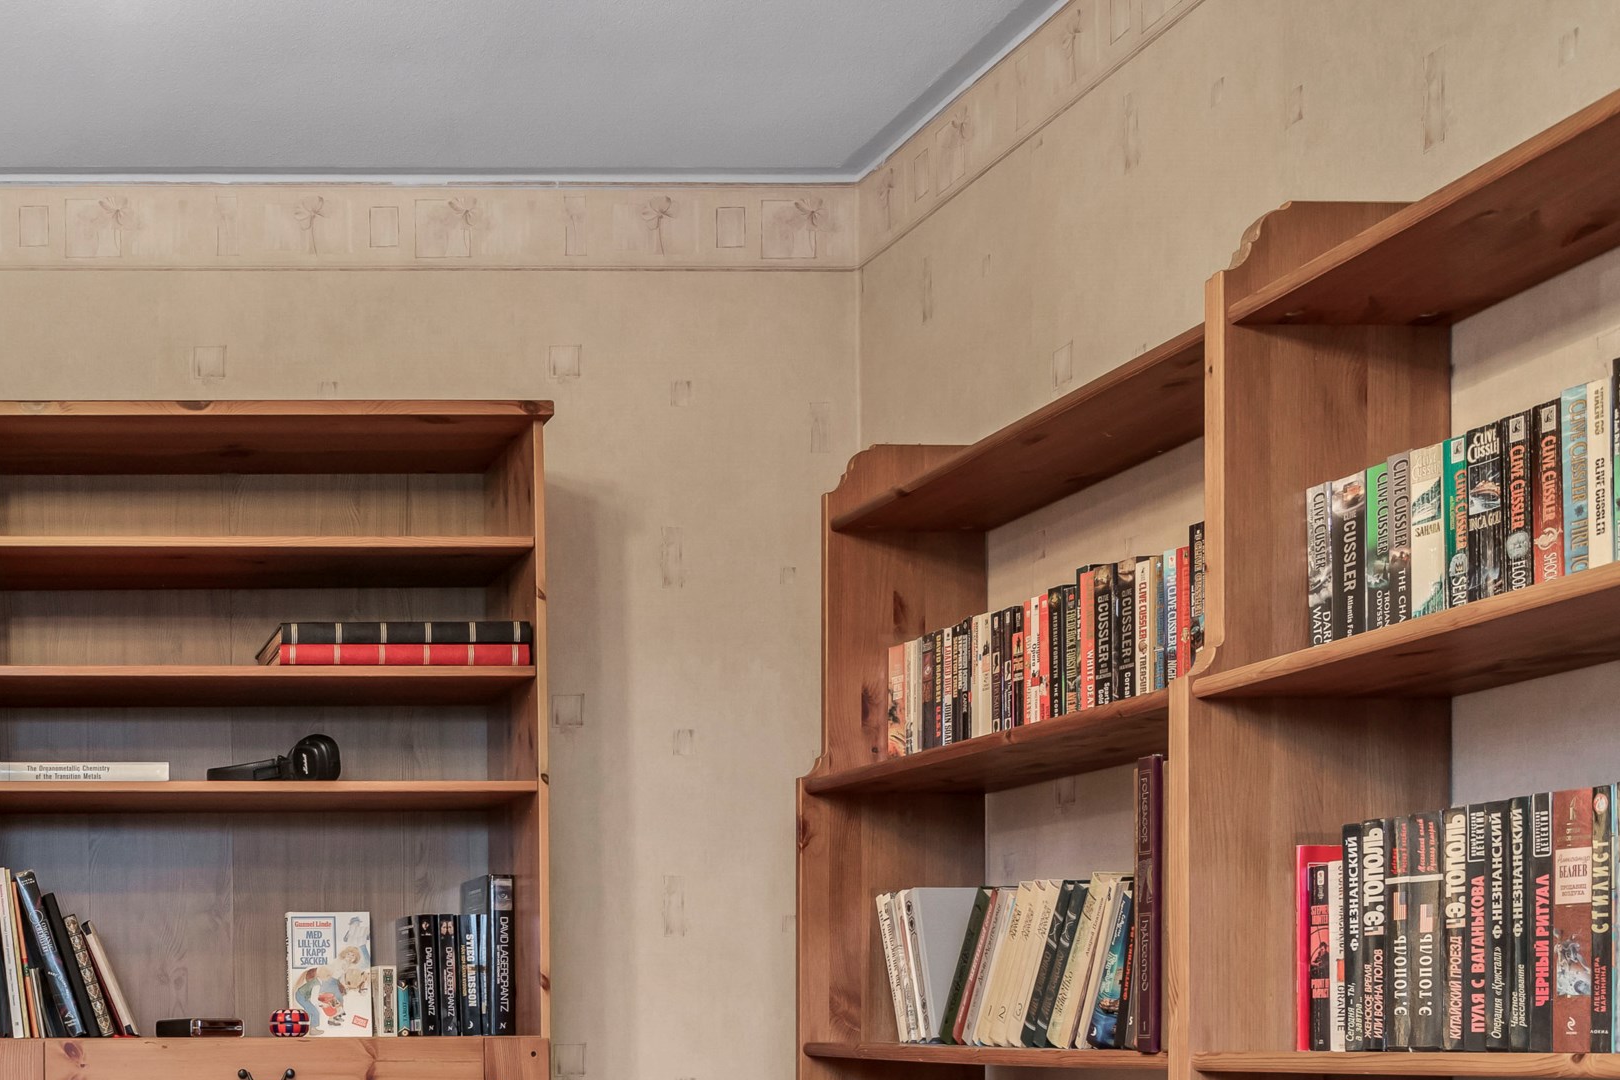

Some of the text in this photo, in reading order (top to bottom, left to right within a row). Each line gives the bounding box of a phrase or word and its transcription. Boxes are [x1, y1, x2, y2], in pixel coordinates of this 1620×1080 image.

[1377, 472, 1389, 556] CLIVE CUSSLER
[1392, 459, 1410, 547] CLIVE CUSSLER
[1510, 445, 1526, 530] CLIVE CUSSLER
[1541, 435, 1556, 521] CLIVE CUSSLER
[1594, 457, 1606, 536] CLIVE CUSSLER
[1313, 492, 1327, 570] CLIVE CUSSLER
[1343, 522, 1357, 593] CUSSLER
[1195, 540, 1203, 617] CLIVE CUSSLER
[1097, 603, 1110, 662] CUSSLER
[26, 765, 111, 774] The Organometallic Chemistry
[35, 772, 42, 780] of
[1446, 814, 1466, 918] Э.ТОПОЛЬ
[1475, 811, 1485, 855] ДЕТЕКТИВ
[1540, 810, 1549, 851] ДЕТЕКТИВ
[1346, 836, 1359, 952] Ф.НЕЗНАНСКИЙ
[1364, 828, 1384, 926] Э.ТОПОЛЬ
[1512, 808, 1523, 937] Ф.НЕЗНАНСКИЙ
[1559, 864, 1588, 878] БЕЛЯЕВ
[1592, 839, 1609, 934] СТИЛИСТ
[294, 920, 332, 928] Gunnel Linde
[297, 939, 331, 948] LILL-KLAS
[300, 956, 328, 966] SÄCKEN
[301, 948, 326, 957] I KAPP
[305, 930, 323, 939] MED
[1470, 874, 1485, 1032] ПУЛЯ С ВАГАНЬКОВА
[1489, 812, 1504, 1039] Операция «Кристалл» Ф.НЕЗНАНСКИЙ
[1534, 873, 1549, 1007] ЧЕРНЫЙ РИТУАЛ
[465, 933, 477, 1007] STIEG LARSSON
[500, 916, 509, 1012] DAVID LAGERCRANTZ
[1372, 949, 1384, 1039] ИЛИ ВОЙНА ПОЛОВ
[1393, 934, 1408, 1015] Э.ТОПОЛЬ
[1419, 933, 1433, 1016] Э.ТОПОЛЬ
[1449, 936, 1462, 1040] КИТАЙСКИЙ ПРОЕЗД
[1517, 964, 1527, 1027] расследование
[998, 1005, 1007, 1019] 2
[1015, 1002, 1023, 1017] 3
[1511, 991, 1519, 1028] Частное
